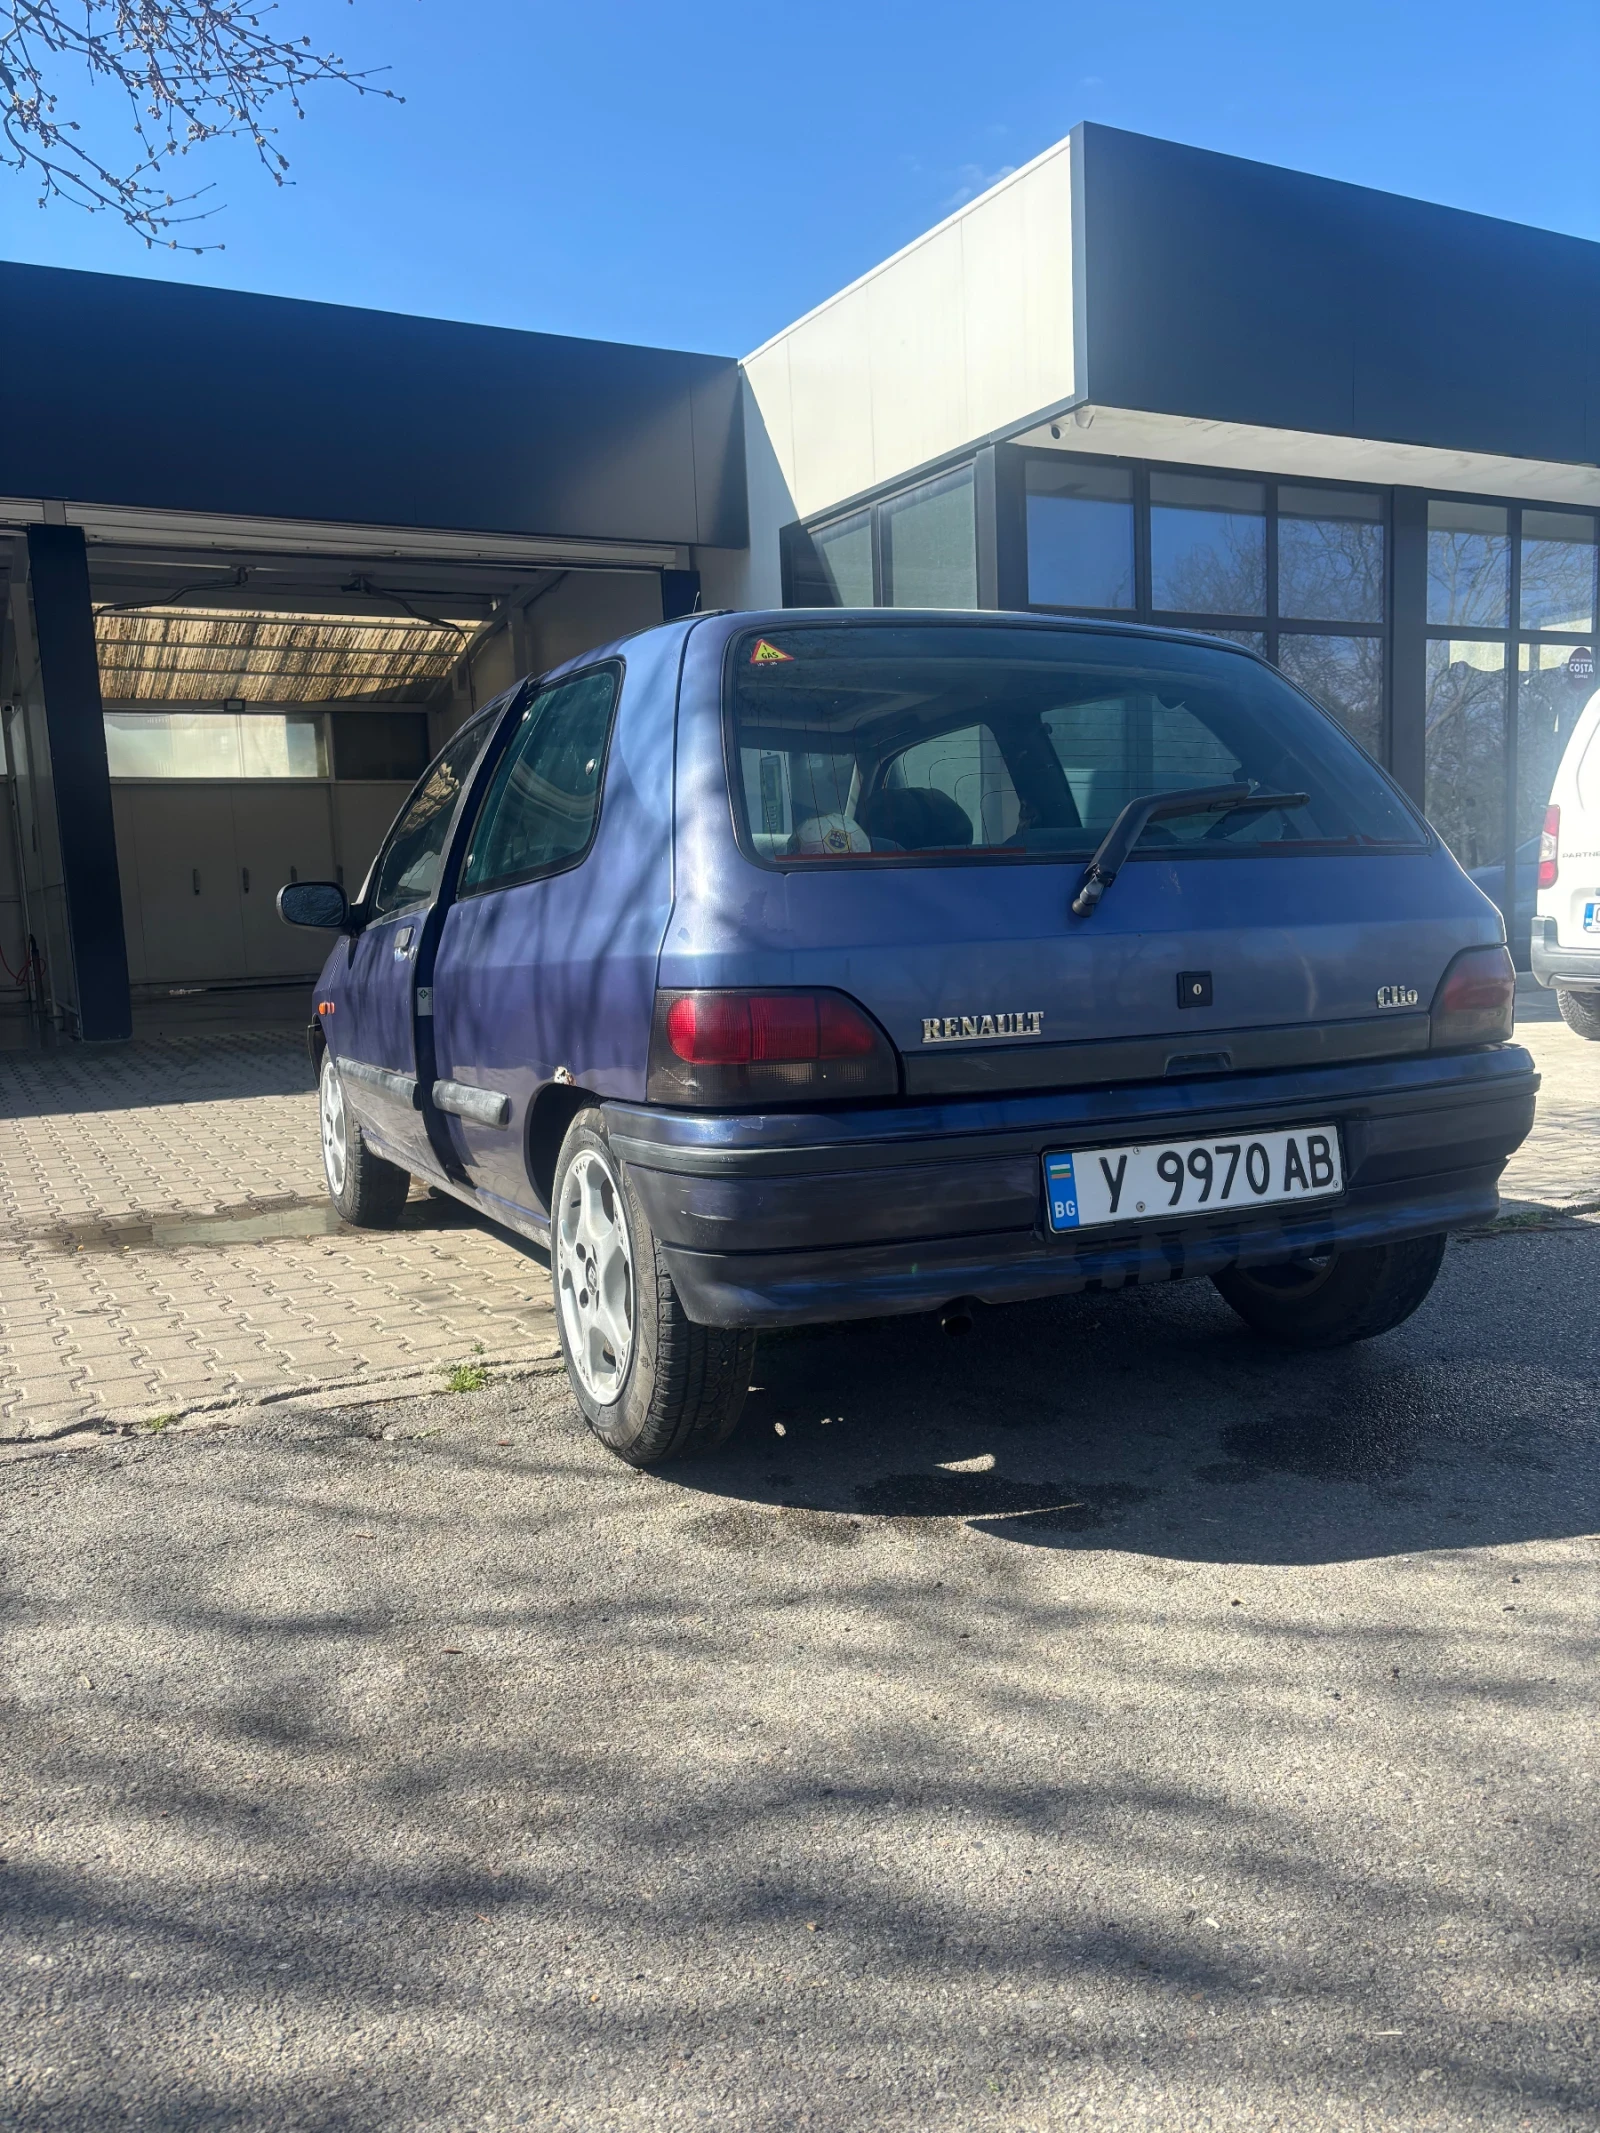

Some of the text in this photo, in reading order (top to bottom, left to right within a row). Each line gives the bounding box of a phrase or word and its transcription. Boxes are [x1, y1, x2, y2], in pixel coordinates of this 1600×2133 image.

[761, 651, 779, 659] GAS
[1570, 663, 1593, 673] COSTA
[1378, 985, 1418, 1009] Clio
[922, 1011, 1044, 1043] RENAULT
[1156, 1142, 1271, 1206] 9970
[1283, 1135, 1334, 1192] AB
[1054, 1200, 1076, 1218] BG
